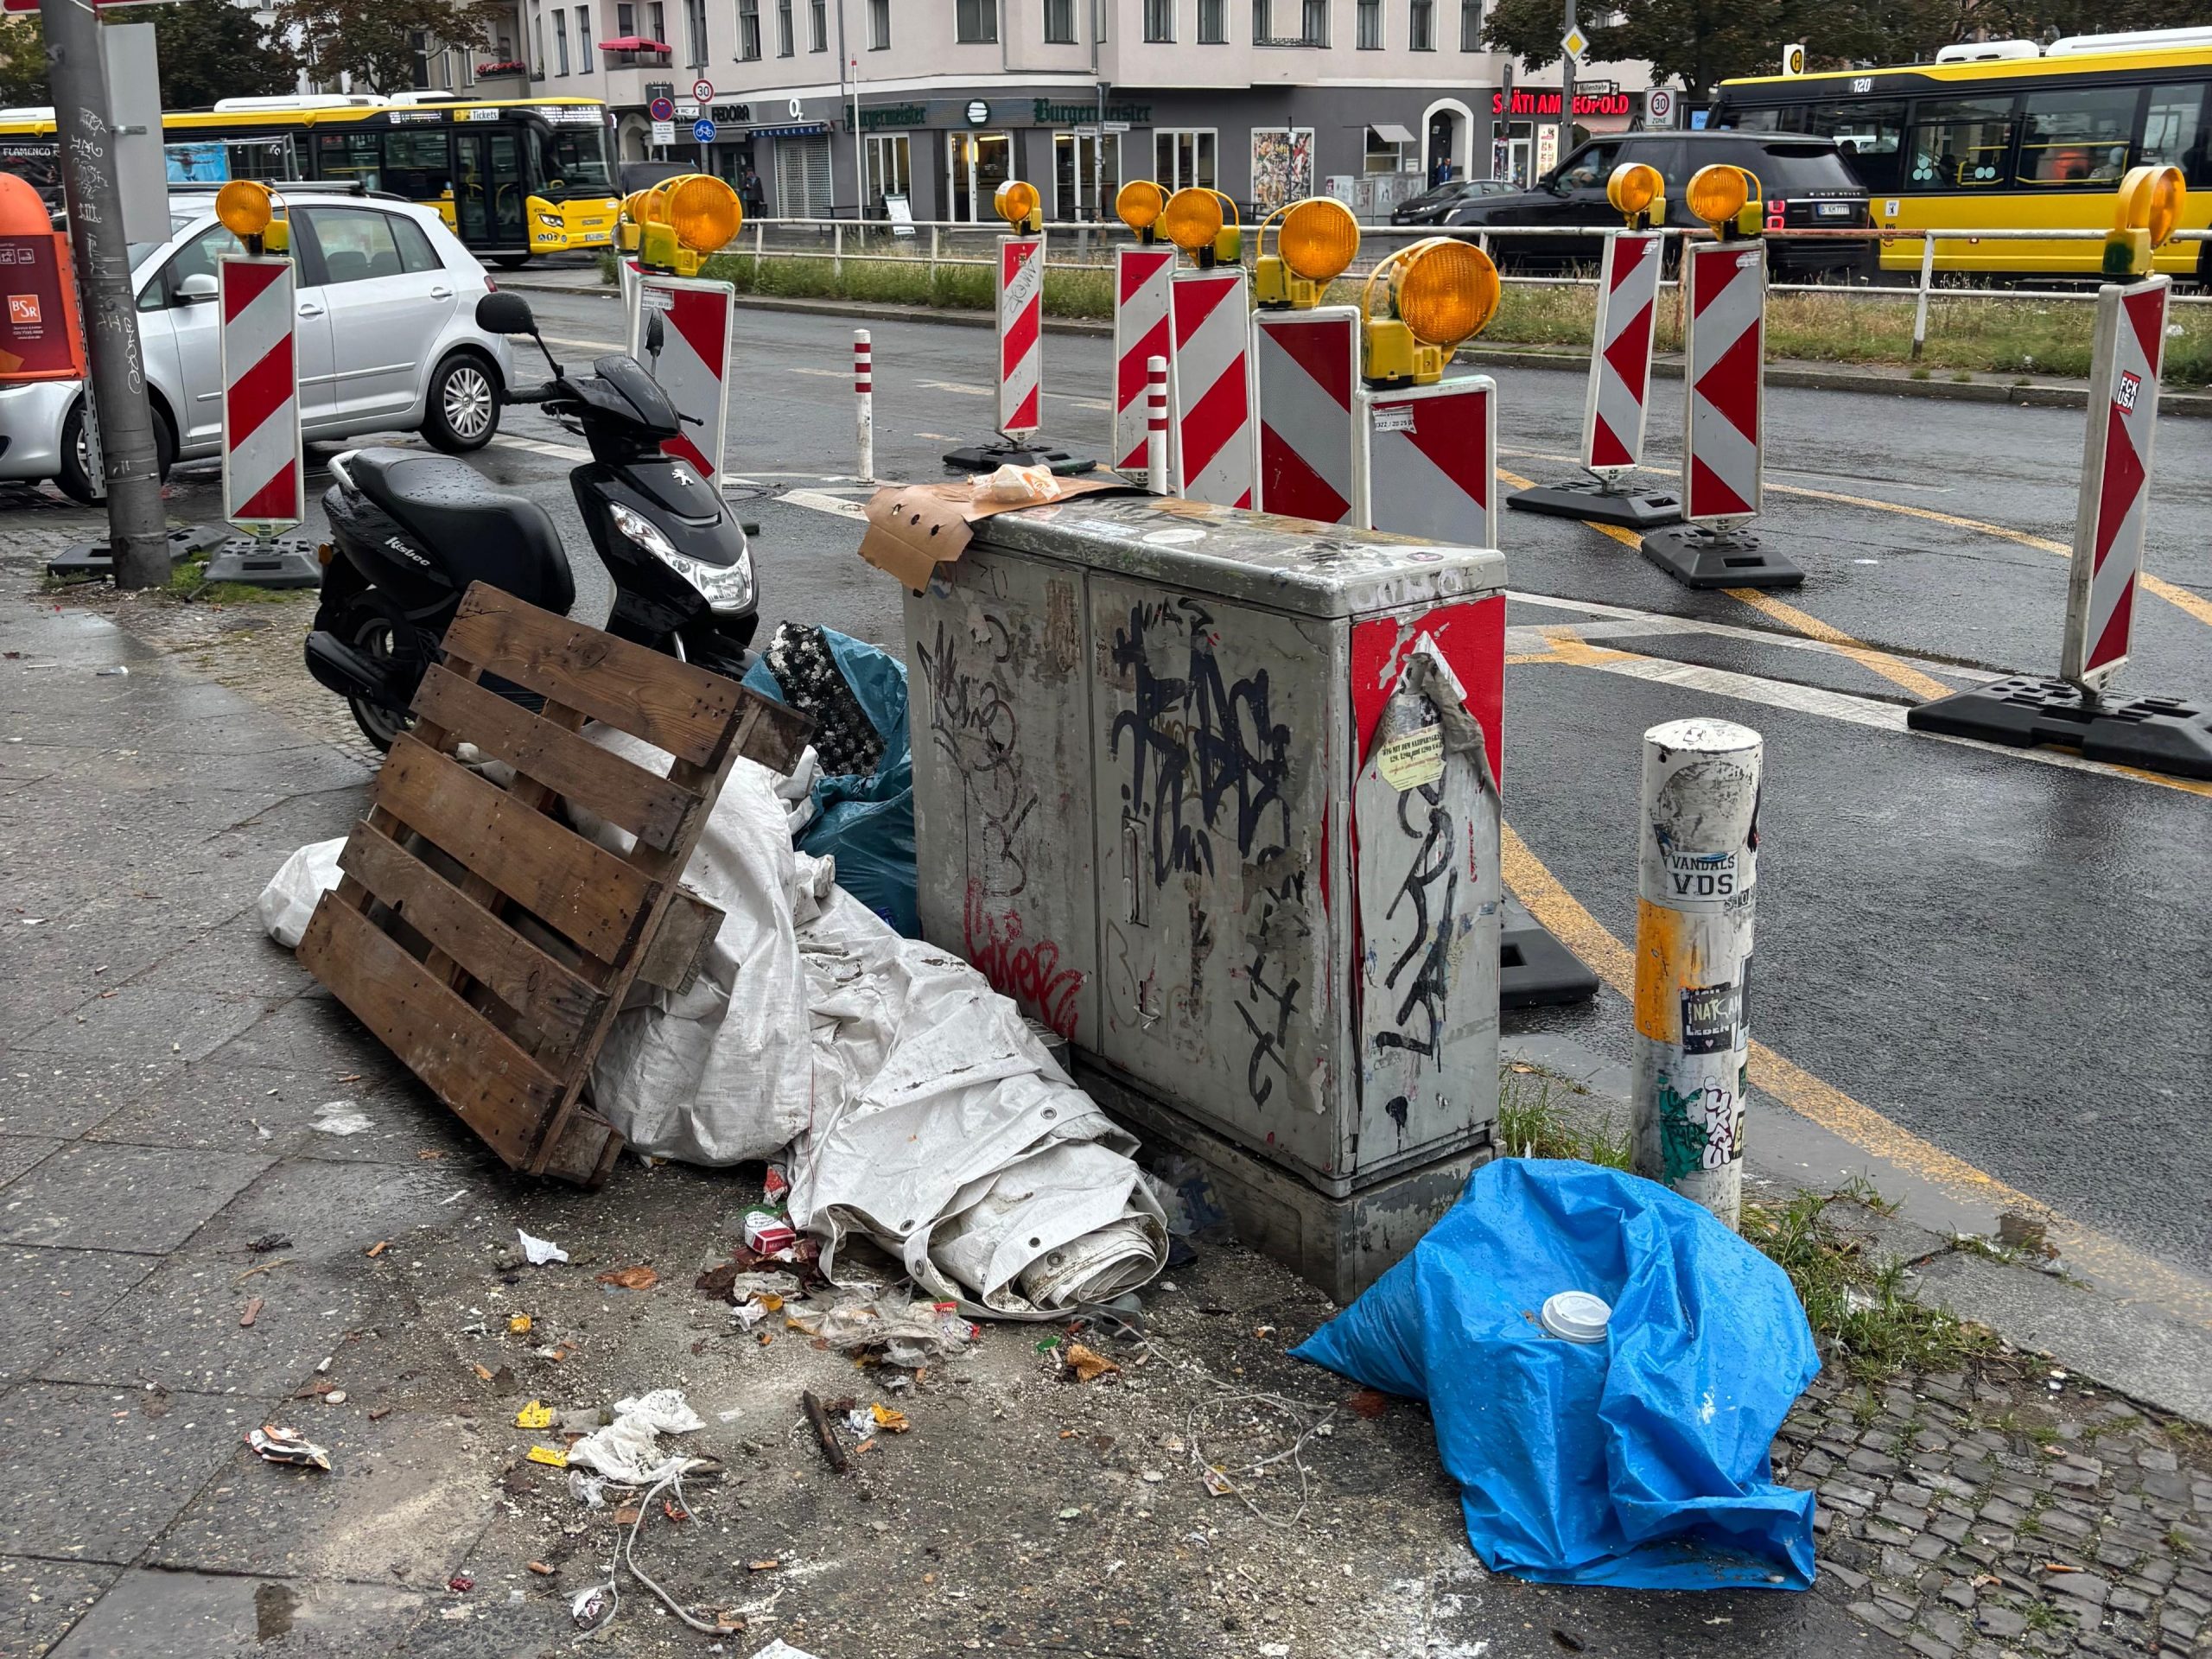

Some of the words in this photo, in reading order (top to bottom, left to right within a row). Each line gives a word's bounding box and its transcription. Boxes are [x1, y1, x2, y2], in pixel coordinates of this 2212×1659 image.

[697, 86, 709, 97] 30
[1853, 78, 1871, 92] 120
[1492, 89, 1535, 114] SÄTI
[1536, 94, 1561, 114] AM
[1572, 95, 1630, 114] EOPOLD
[1655, 99, 1666, 110] 30
[473, 110, 498, 120] Tickets
[12, 301, 38, 318] BSR
[2120, 377, 2139, 397] FCK
[2117, 391, 2134, 410] USA
[385, 537, 430, 566] Kisbee
[1672, 855, 1735, 871] VANDALS
[1672, 873, 1733, 896] VDS
